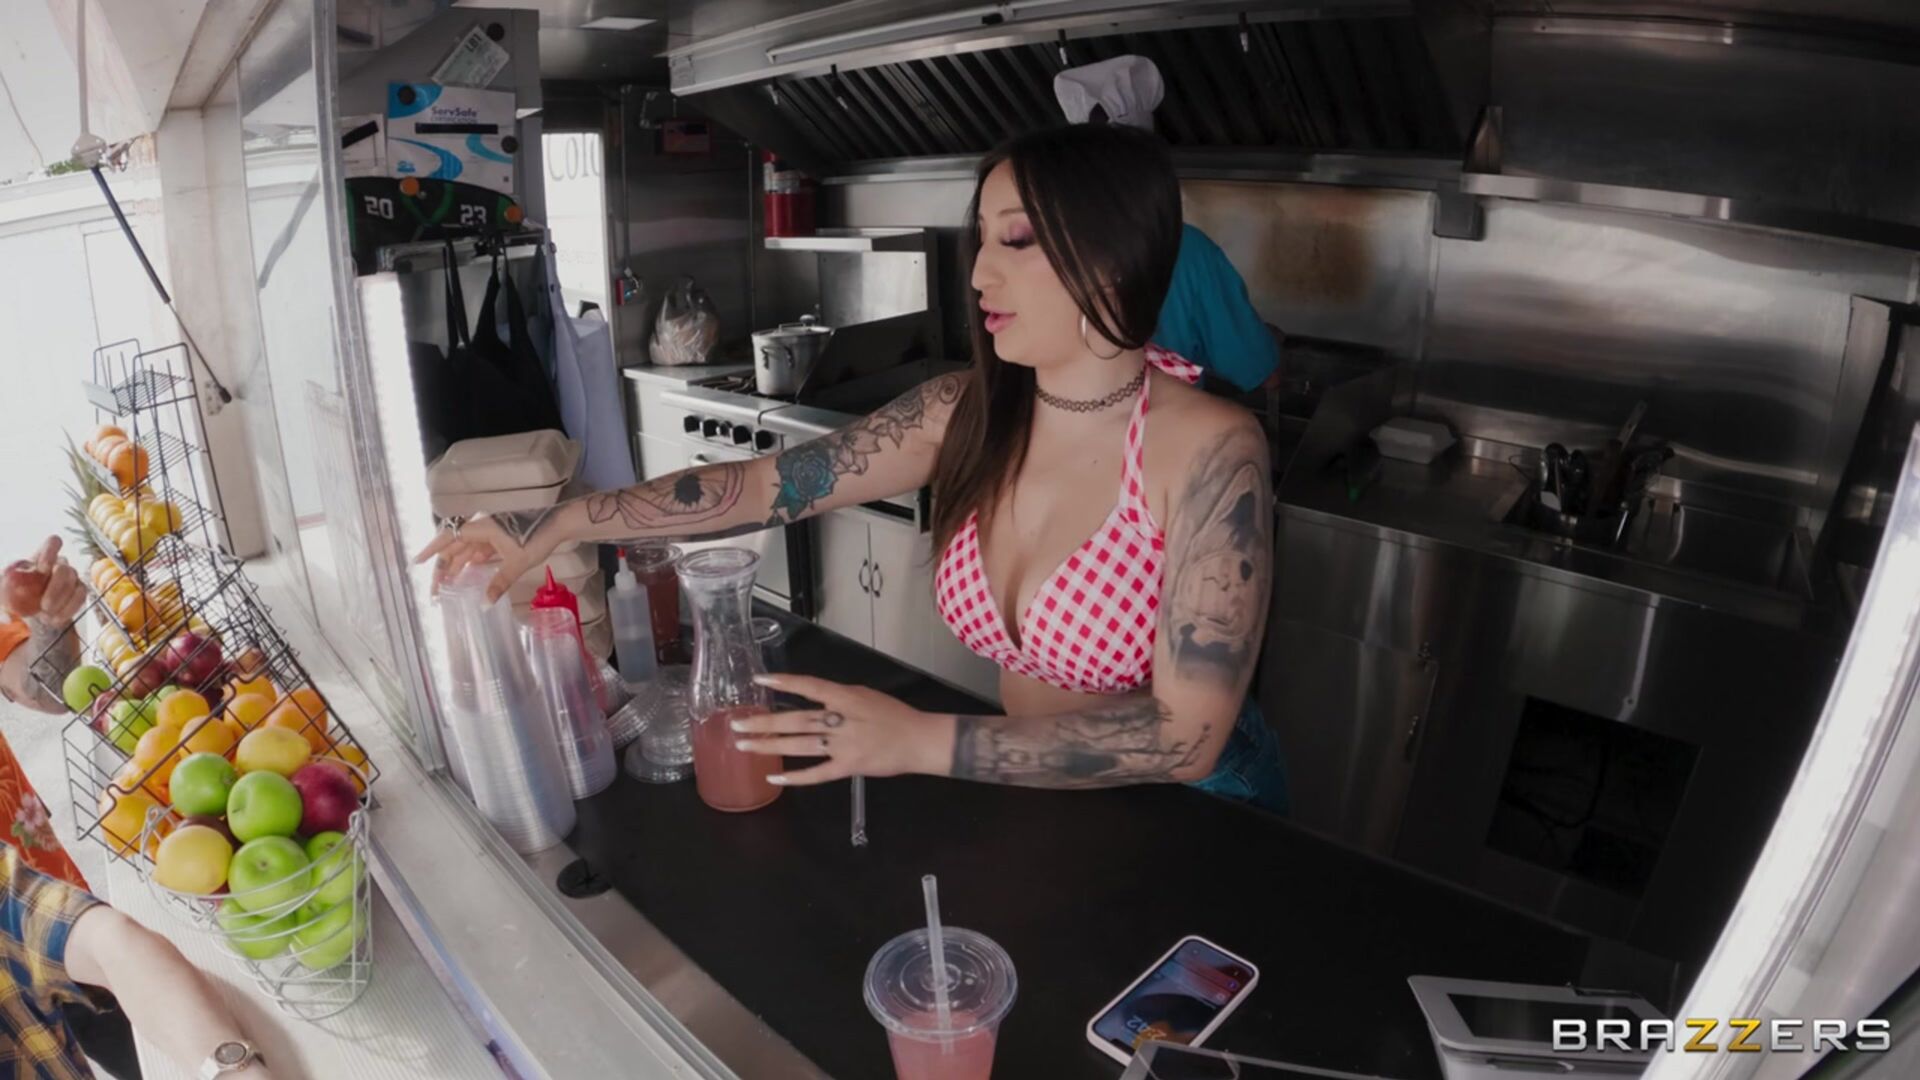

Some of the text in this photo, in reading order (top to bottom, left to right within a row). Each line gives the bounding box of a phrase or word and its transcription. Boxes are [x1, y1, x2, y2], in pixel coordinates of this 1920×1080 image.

[431, 106, 478, 119] ServSafe
[364, 196, 394, 220] 20
[460, 204, 487, 226] 23
